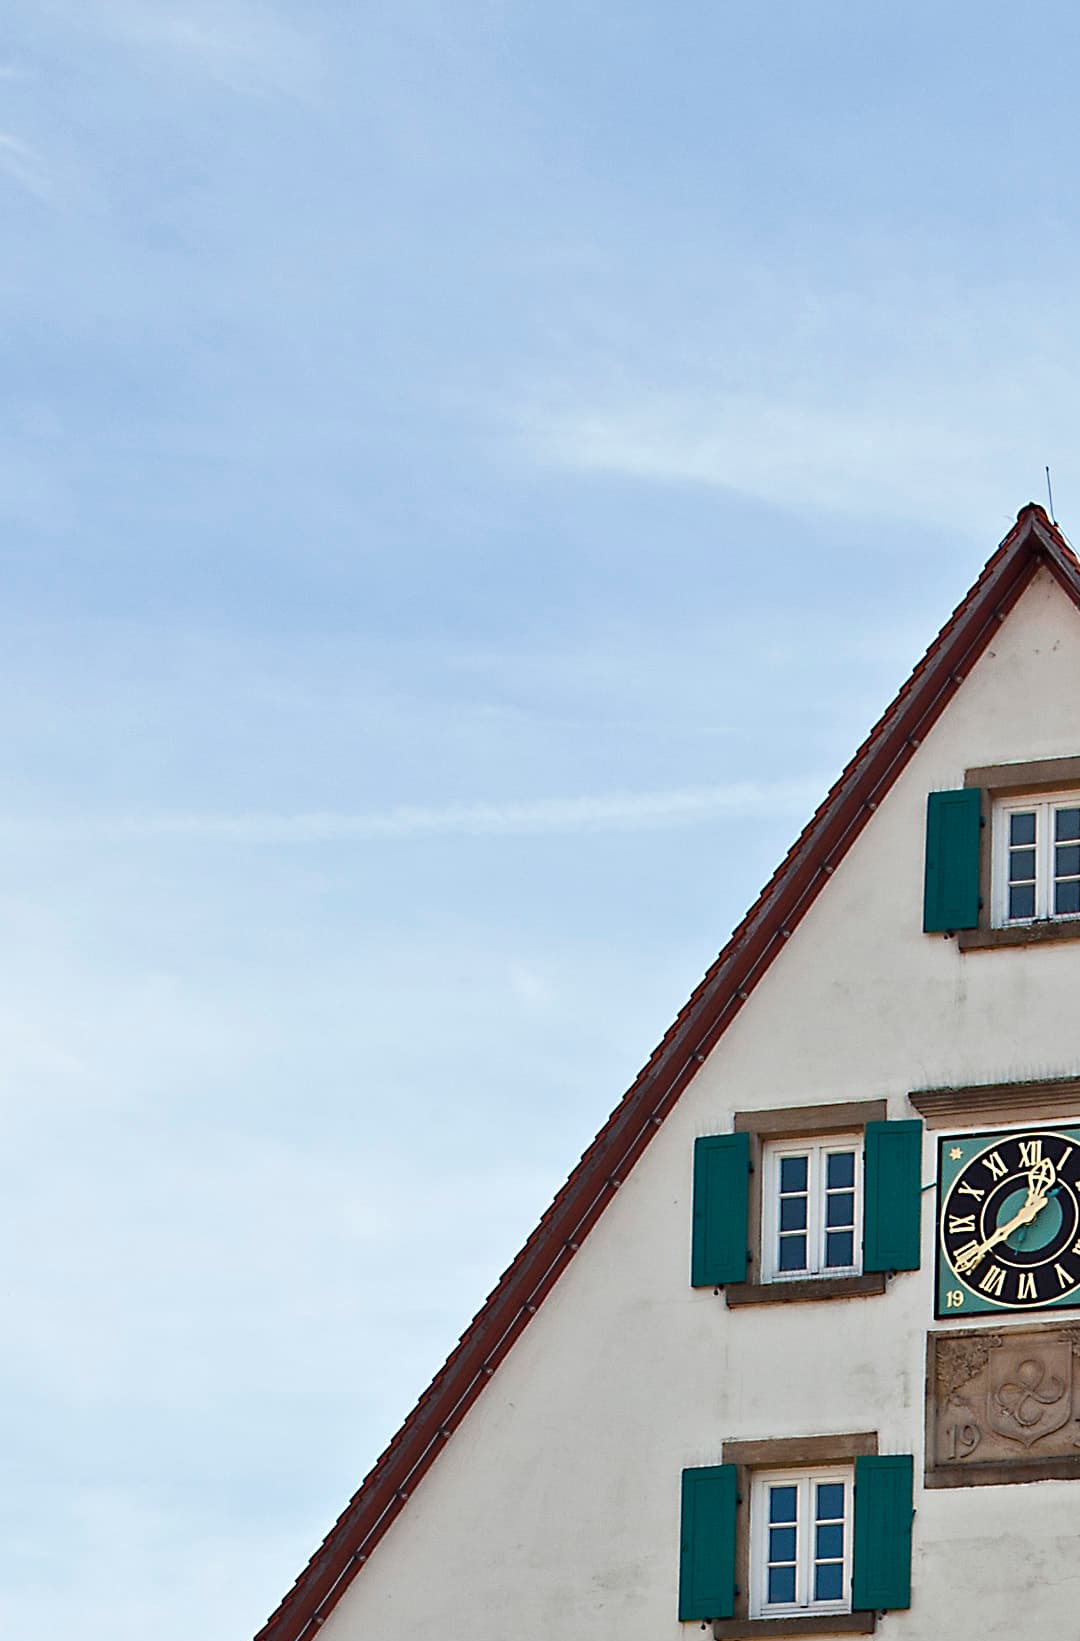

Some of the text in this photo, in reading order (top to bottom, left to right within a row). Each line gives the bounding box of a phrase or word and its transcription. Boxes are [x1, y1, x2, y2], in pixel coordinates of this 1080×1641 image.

[982, 1151, 1009, 1182] XI
[1018, 1140, 1043, 1169] XII
[1056, 1147, 1073, 1171] I
[958, 1180, 985, 1202] X
[948, 1214, 976, 1234] IX
[978, 1265, 1007, 1297] VII
[1017, 1272, 1037, 1300] VI
[1053, 1263, 1075, 1289] V
[946, 1290, 965, 1308] 19
[946, 1423, 982, 1460] 19
